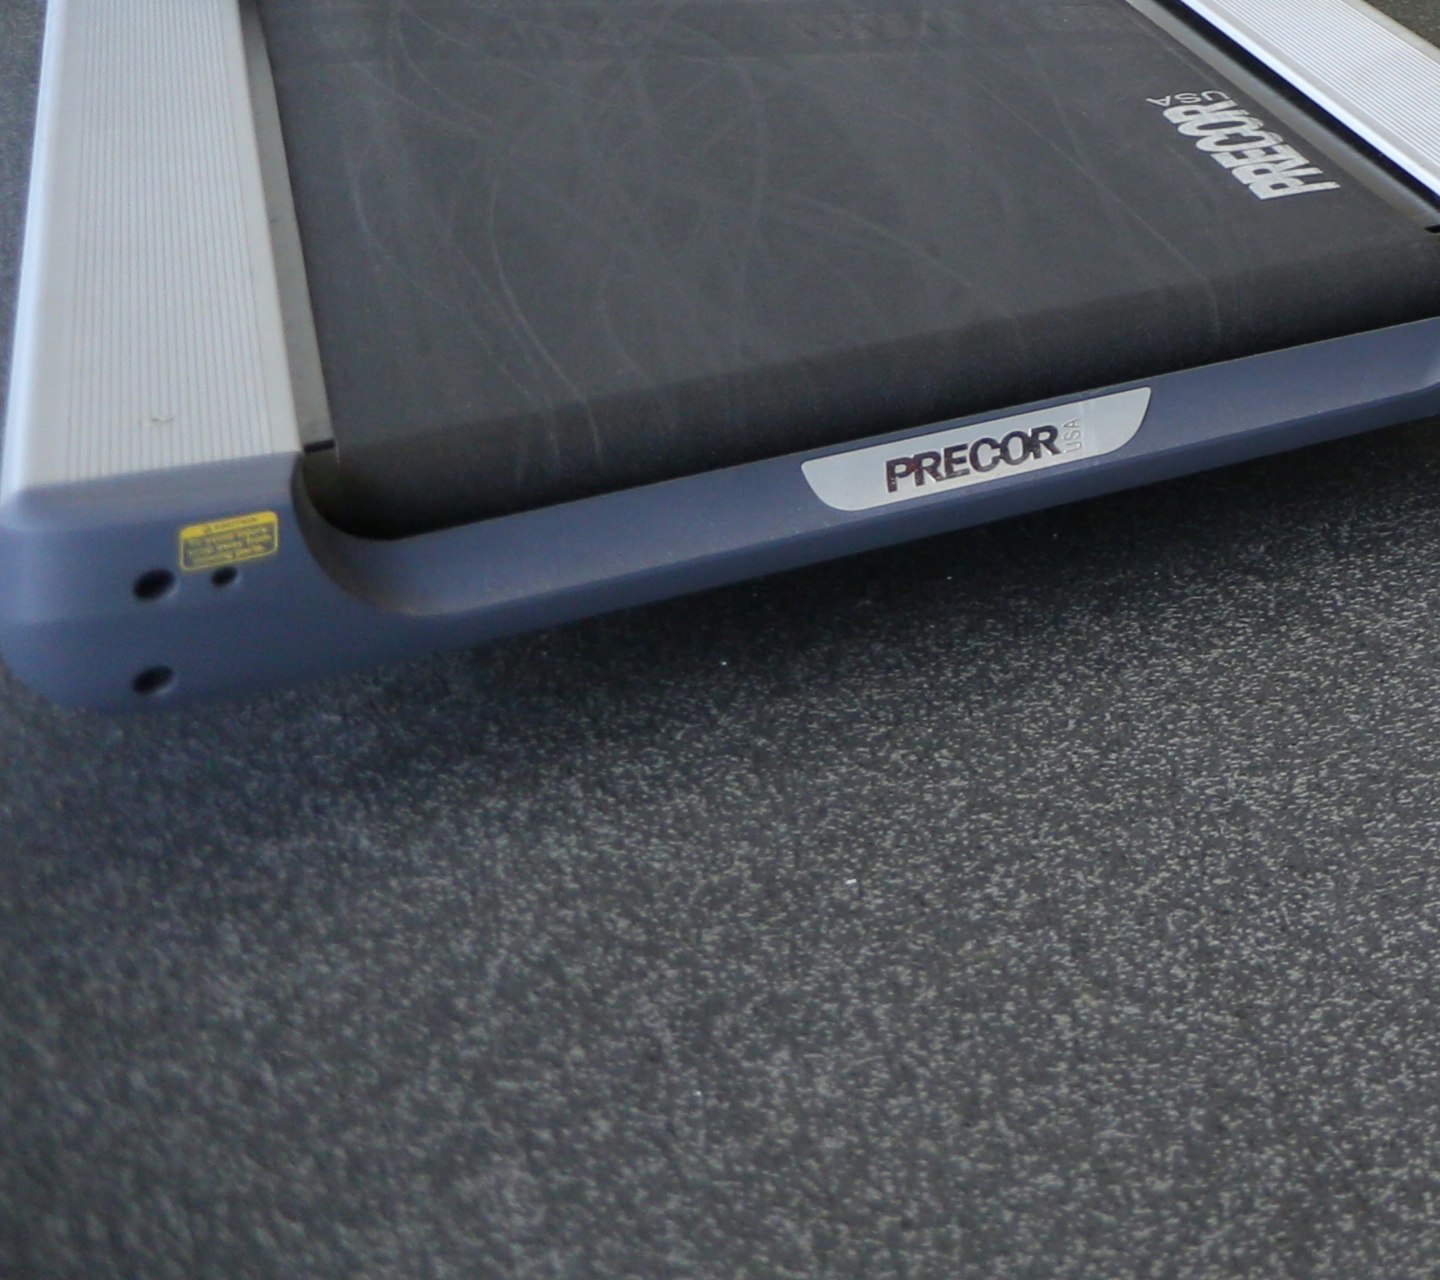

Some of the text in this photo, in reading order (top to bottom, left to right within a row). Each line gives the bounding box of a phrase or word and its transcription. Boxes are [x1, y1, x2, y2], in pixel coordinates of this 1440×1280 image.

[1146, 90, 1231, 107] USA
[1163, 100, 1342, 200] PRECOR
[886, 416, 1083, 493] PRECOR USA
